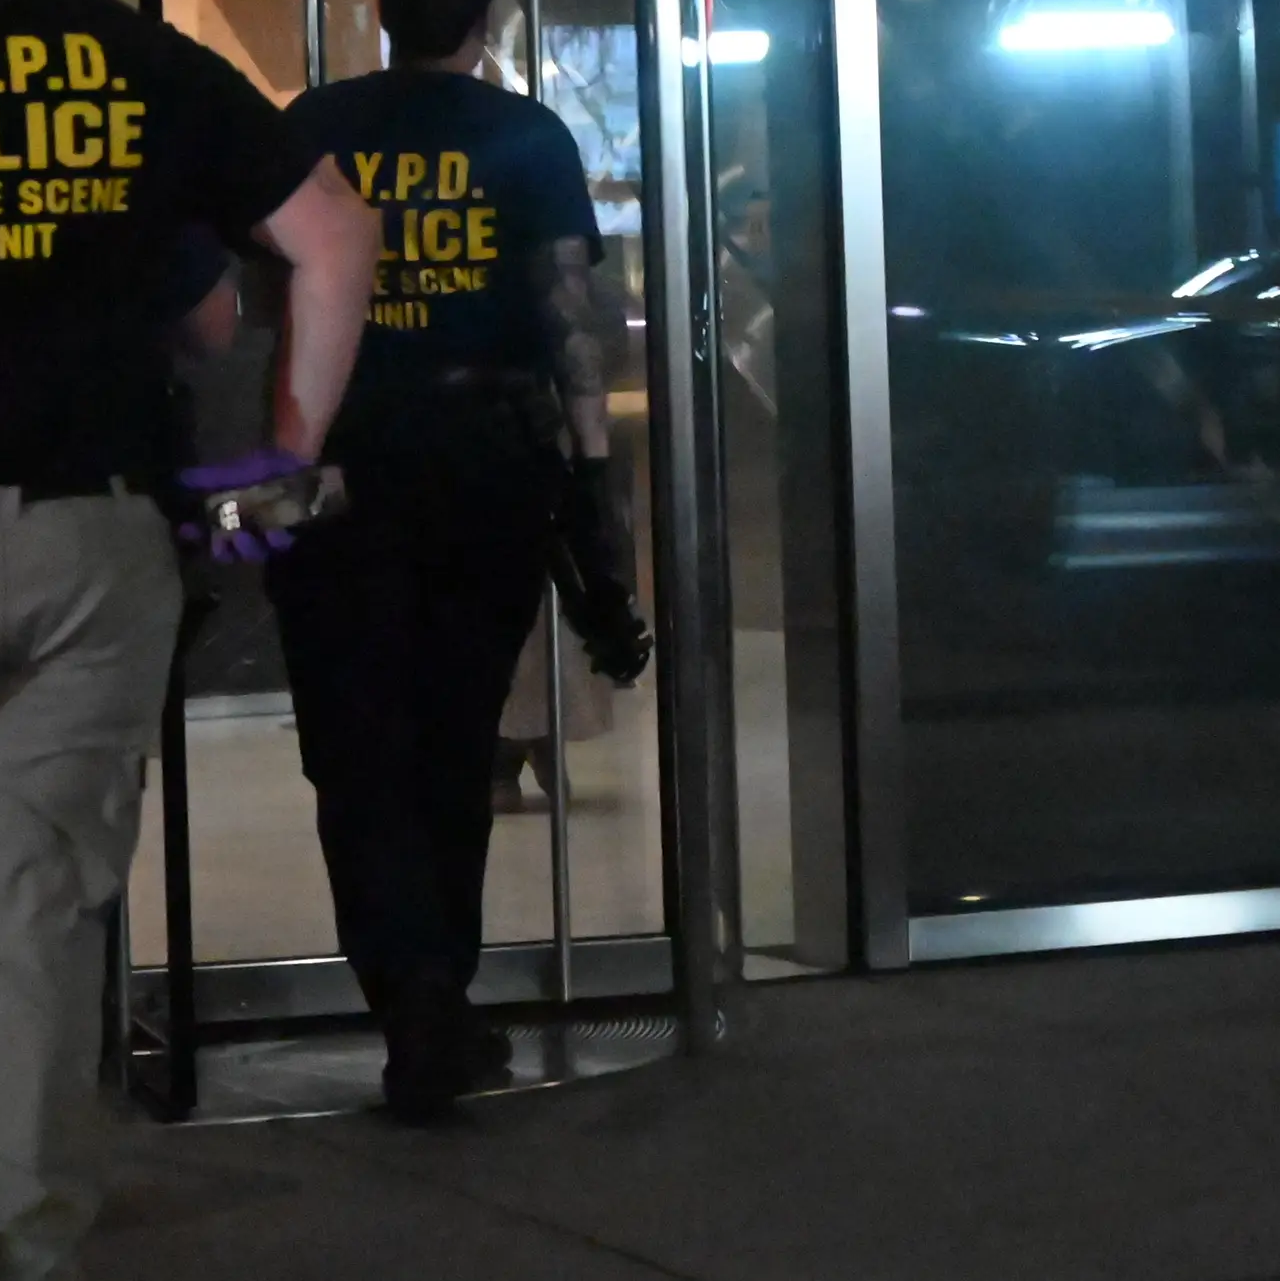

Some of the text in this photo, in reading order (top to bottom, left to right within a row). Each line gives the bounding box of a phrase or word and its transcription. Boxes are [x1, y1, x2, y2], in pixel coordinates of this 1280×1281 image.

[18, 177, 132, 215] SCENE
[352, 150, 486, 201] Y.P.D.
[370, 207, 498, 261] LICE
